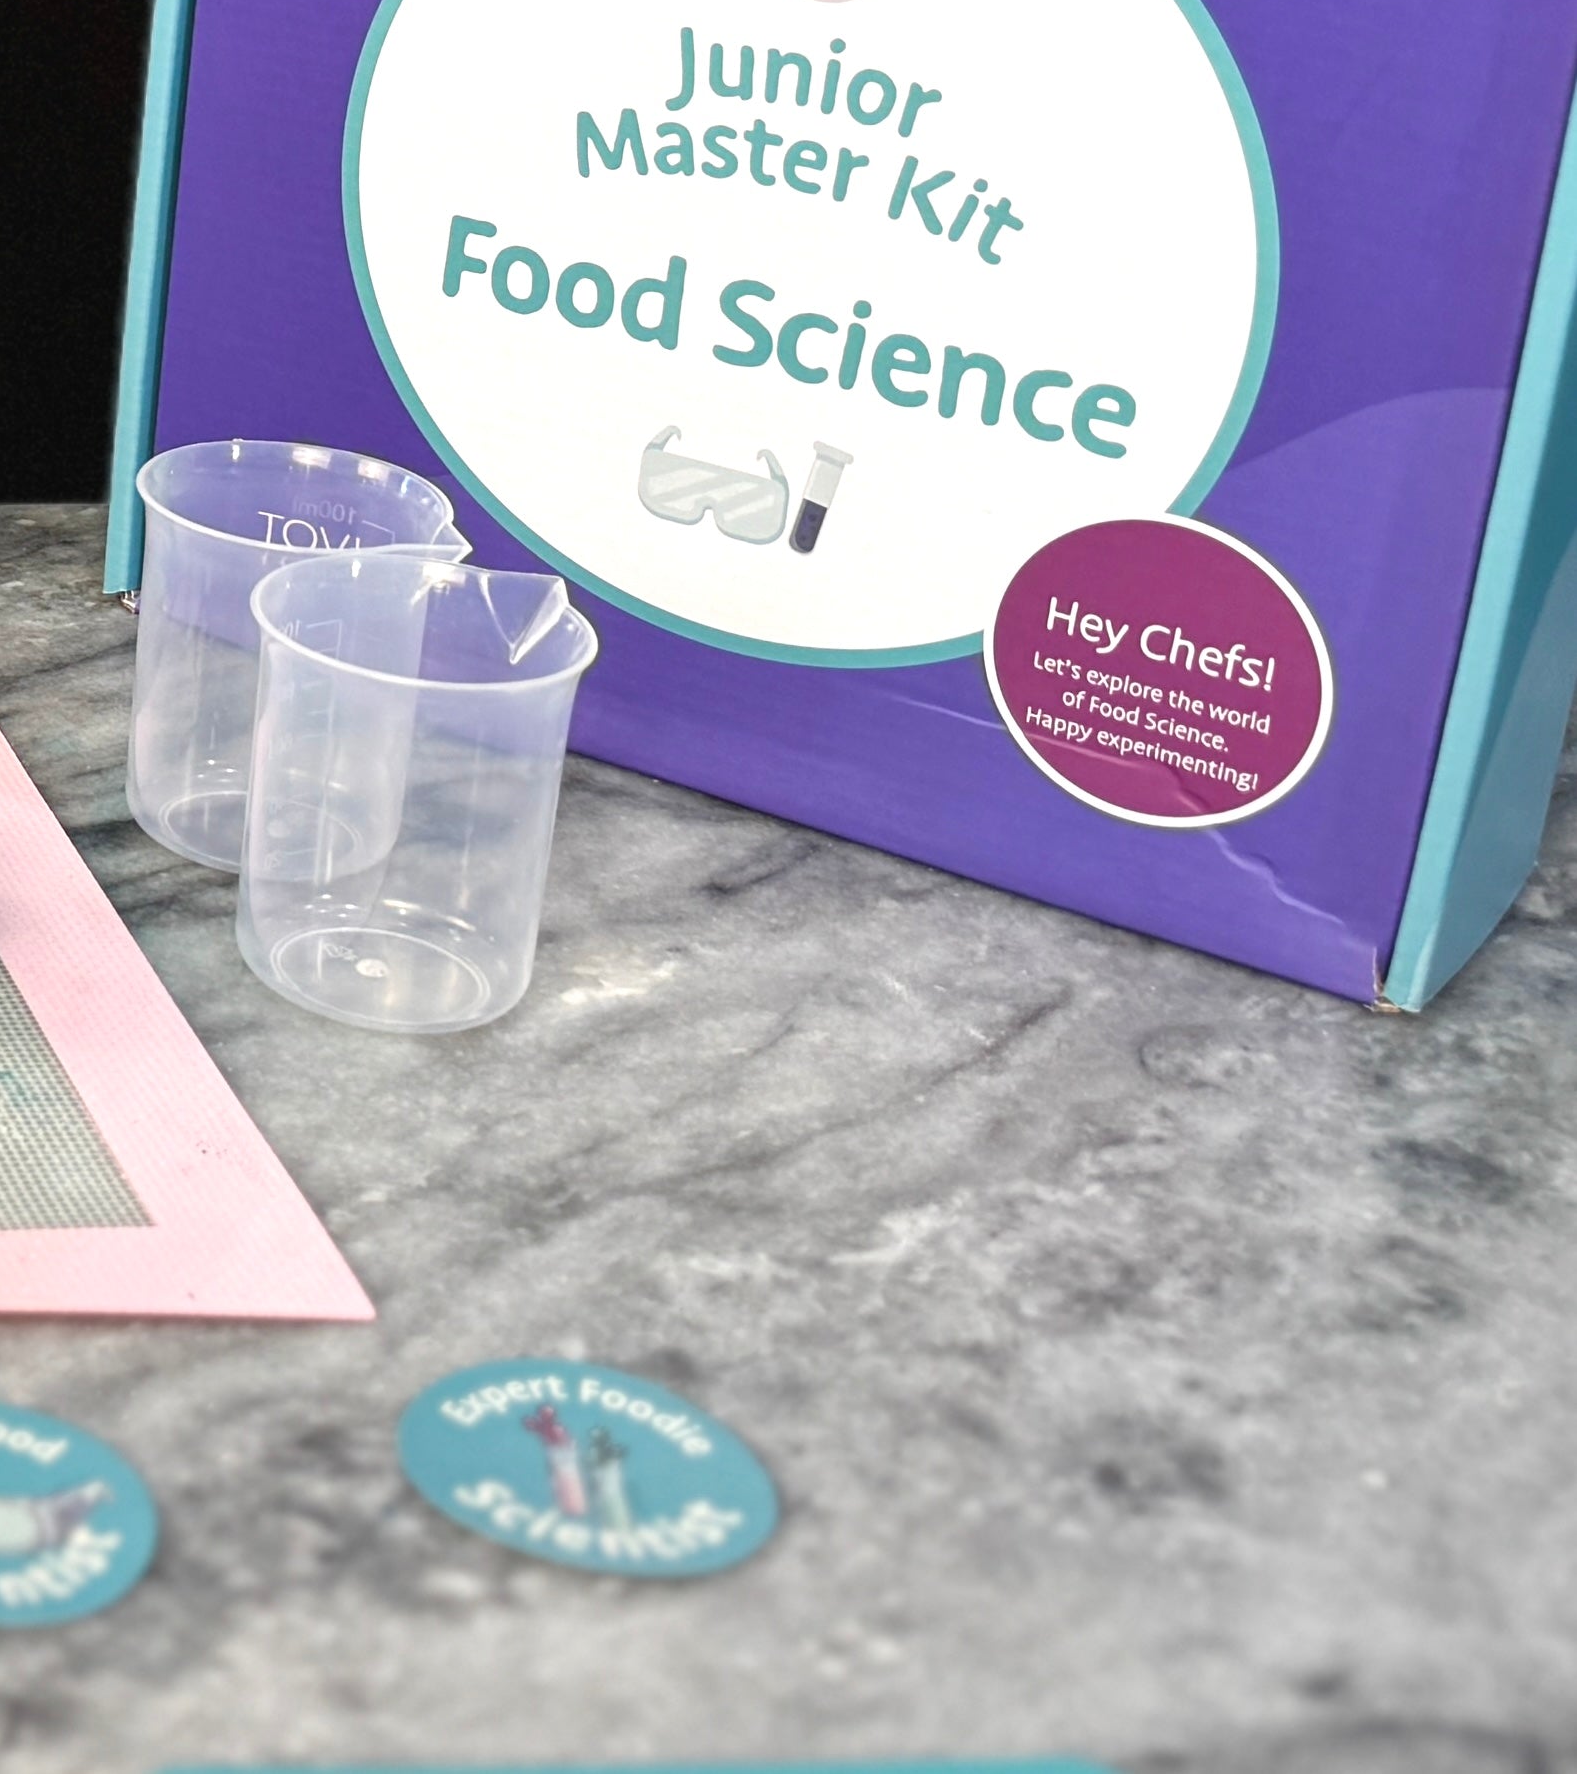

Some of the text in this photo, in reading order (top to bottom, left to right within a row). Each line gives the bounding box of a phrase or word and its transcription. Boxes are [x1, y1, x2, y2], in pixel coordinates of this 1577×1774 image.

[665, 26, 942, 138] Junior
[576, 108, 1024, 265] Master Kit
[442, 214, 1137, 459] Food Science
[1046, 596, 1276, 691] Hey Chefs!
[1033, 651, 1271, 735] Let's explore the world
[1062, 690, 1229, 753] of Food Science.
[1026, 706, 1259, 792] Happy experimenting!
[440, 1375, 713, 1457] Expert Foodie
[453, 1479, 742, 1561] Scientist
